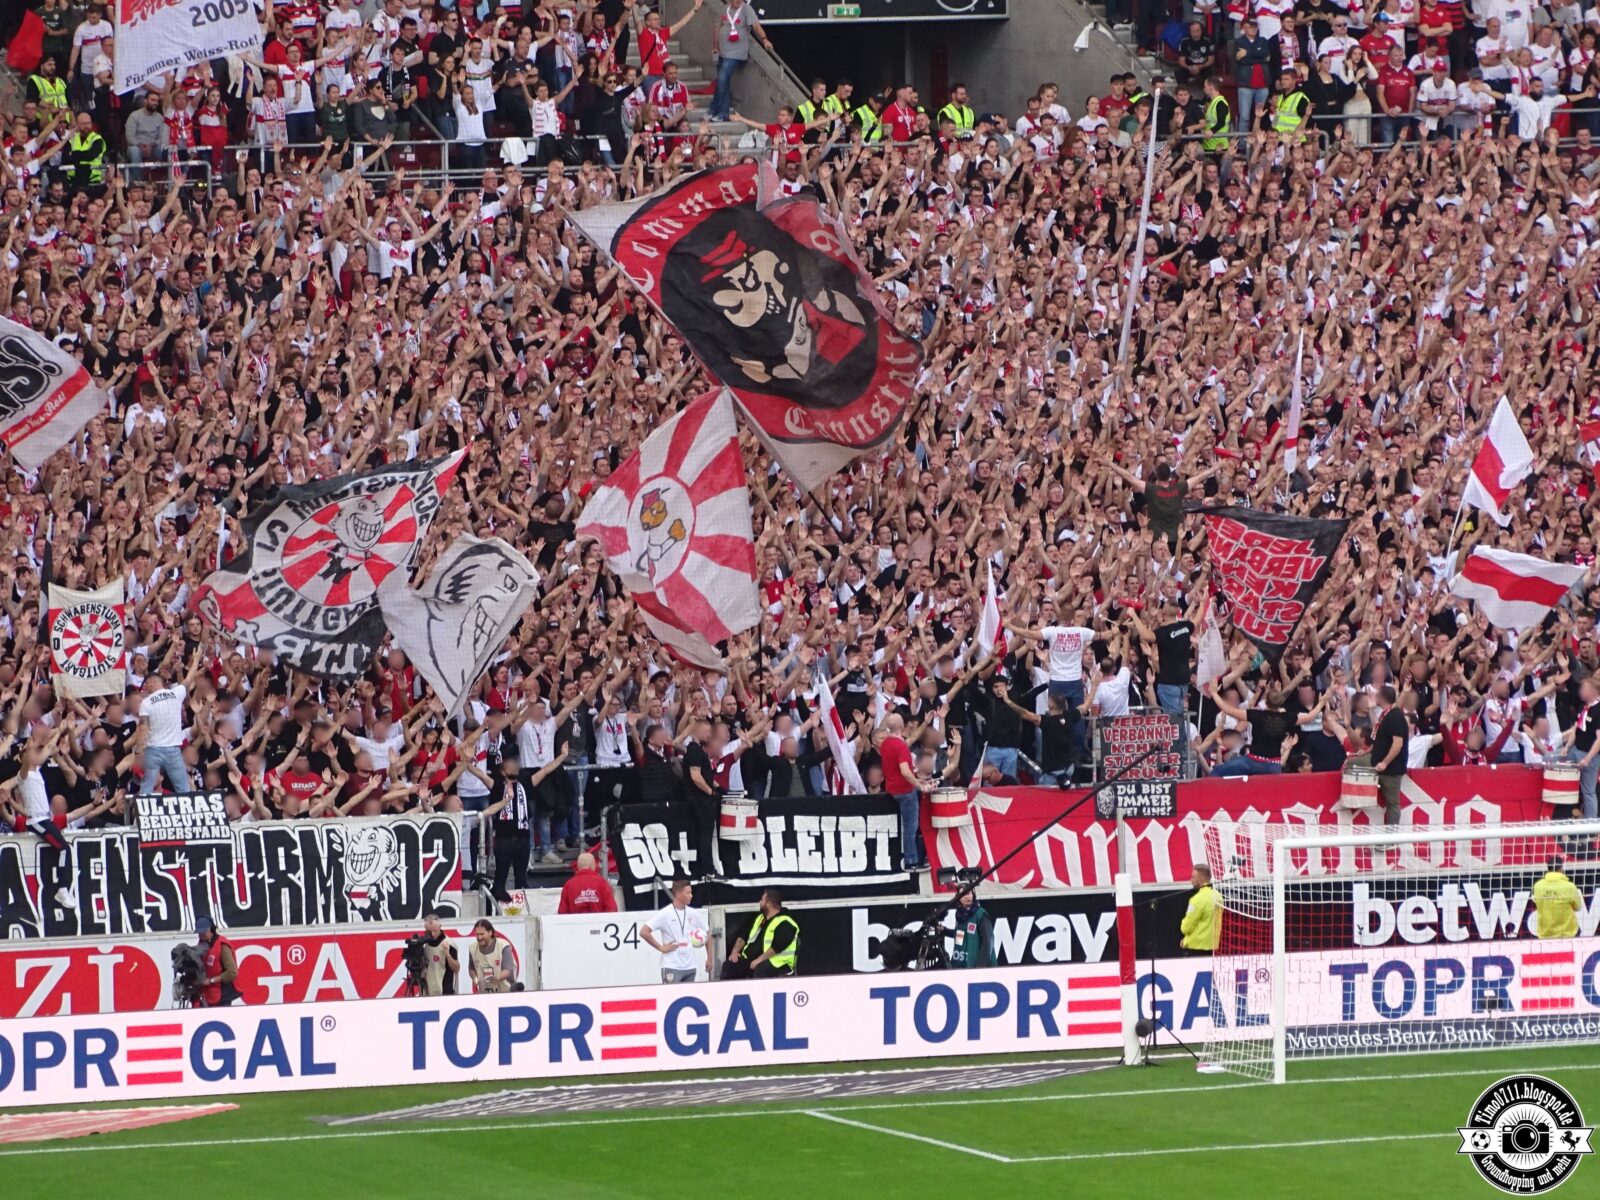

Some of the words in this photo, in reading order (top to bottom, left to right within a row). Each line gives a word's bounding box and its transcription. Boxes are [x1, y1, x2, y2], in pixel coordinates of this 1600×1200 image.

[125, 72, 147, 88] Für
[54, 603, 121, 634] SCHWABENSTURM
[59, 654, 117, 679] STUTTGART
[1111, 713, 1171, 728] JEDER
[1103, 723, 1180, 743] VERBANNTE
[1117, 784, 1136, 795] DU
[1142, 783, 1172, 795] BIST
[136, 794, 225, 816] ULTRAS
[1117, 794, 1172, 807] IMMER
[138, 811, 226, 829] BEDEUTET
[1141, 806, 1173, 817] UNS!
[140, 825, 231, 843] WIDERSTAND
[738, 813, 899, 875] BLEIBT
[603, 922, 640, 951] 34
[1286, 1028, 1436, 1050] Mercedes-Benz
[1442, 1024, 1497, 1043] Bank
